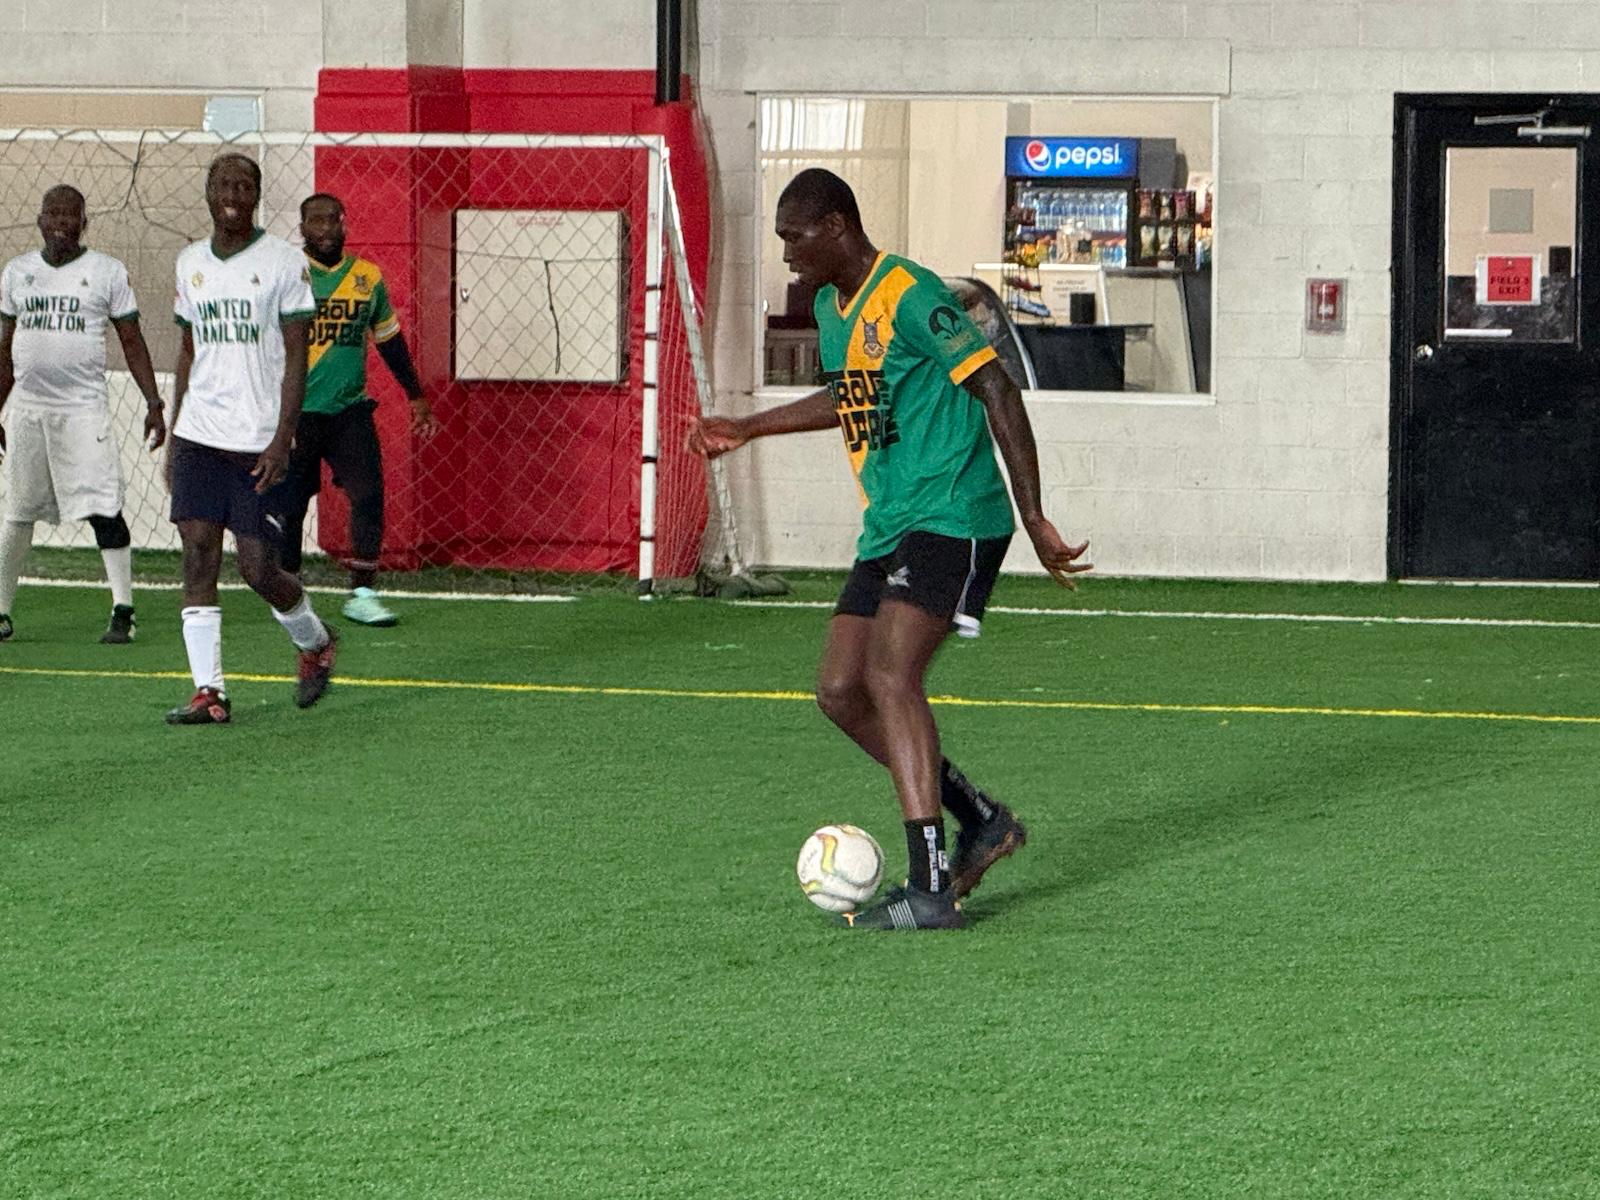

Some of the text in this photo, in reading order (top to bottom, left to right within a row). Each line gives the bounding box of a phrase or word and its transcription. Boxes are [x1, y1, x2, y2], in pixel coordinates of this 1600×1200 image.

[1055, 142, 1120, 170] pepsi
[1498, 285, 1521, 295] EXIT
[25, 296, 81, 313] UNITED
